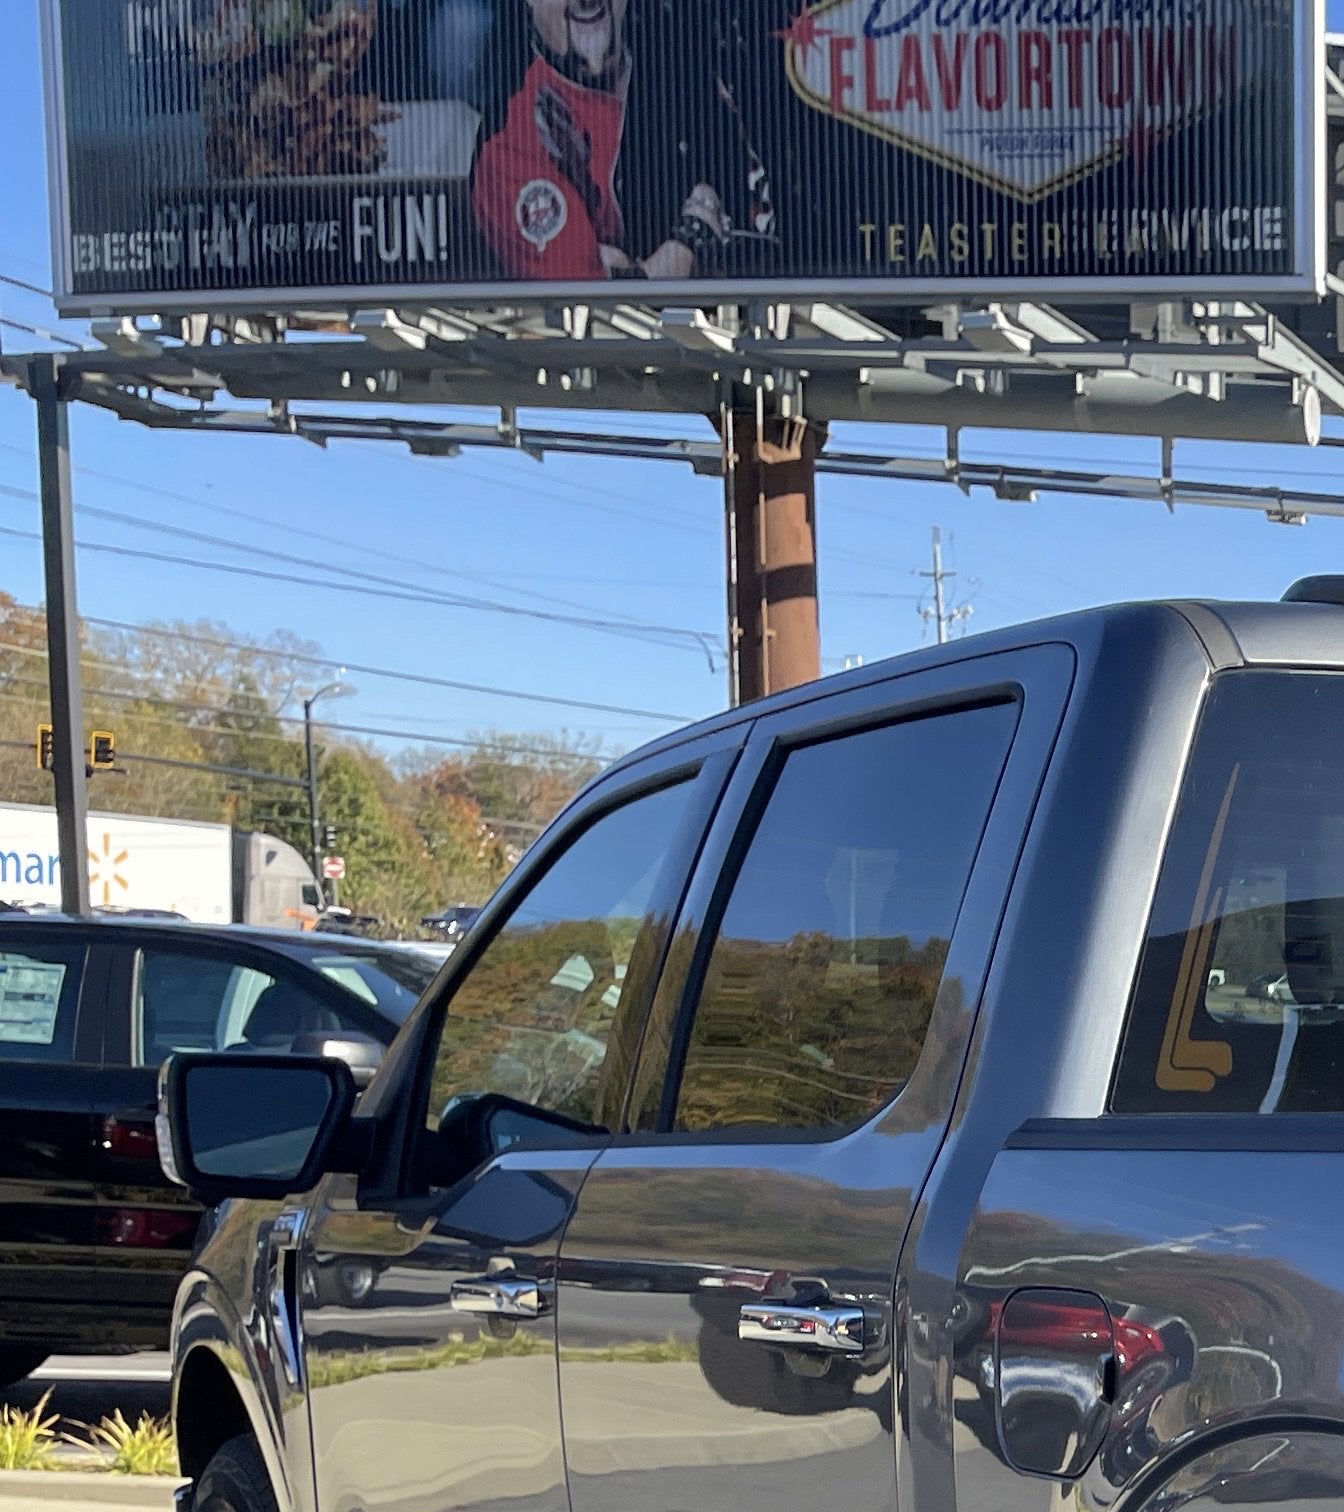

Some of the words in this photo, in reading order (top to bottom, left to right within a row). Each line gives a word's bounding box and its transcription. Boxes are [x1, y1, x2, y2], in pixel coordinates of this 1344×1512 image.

[828, 24, 1237, 114] FLAVORTOWN
[353, 194, 448, 263] FUN!
[859, 223, 1063, 261] TEASTER
